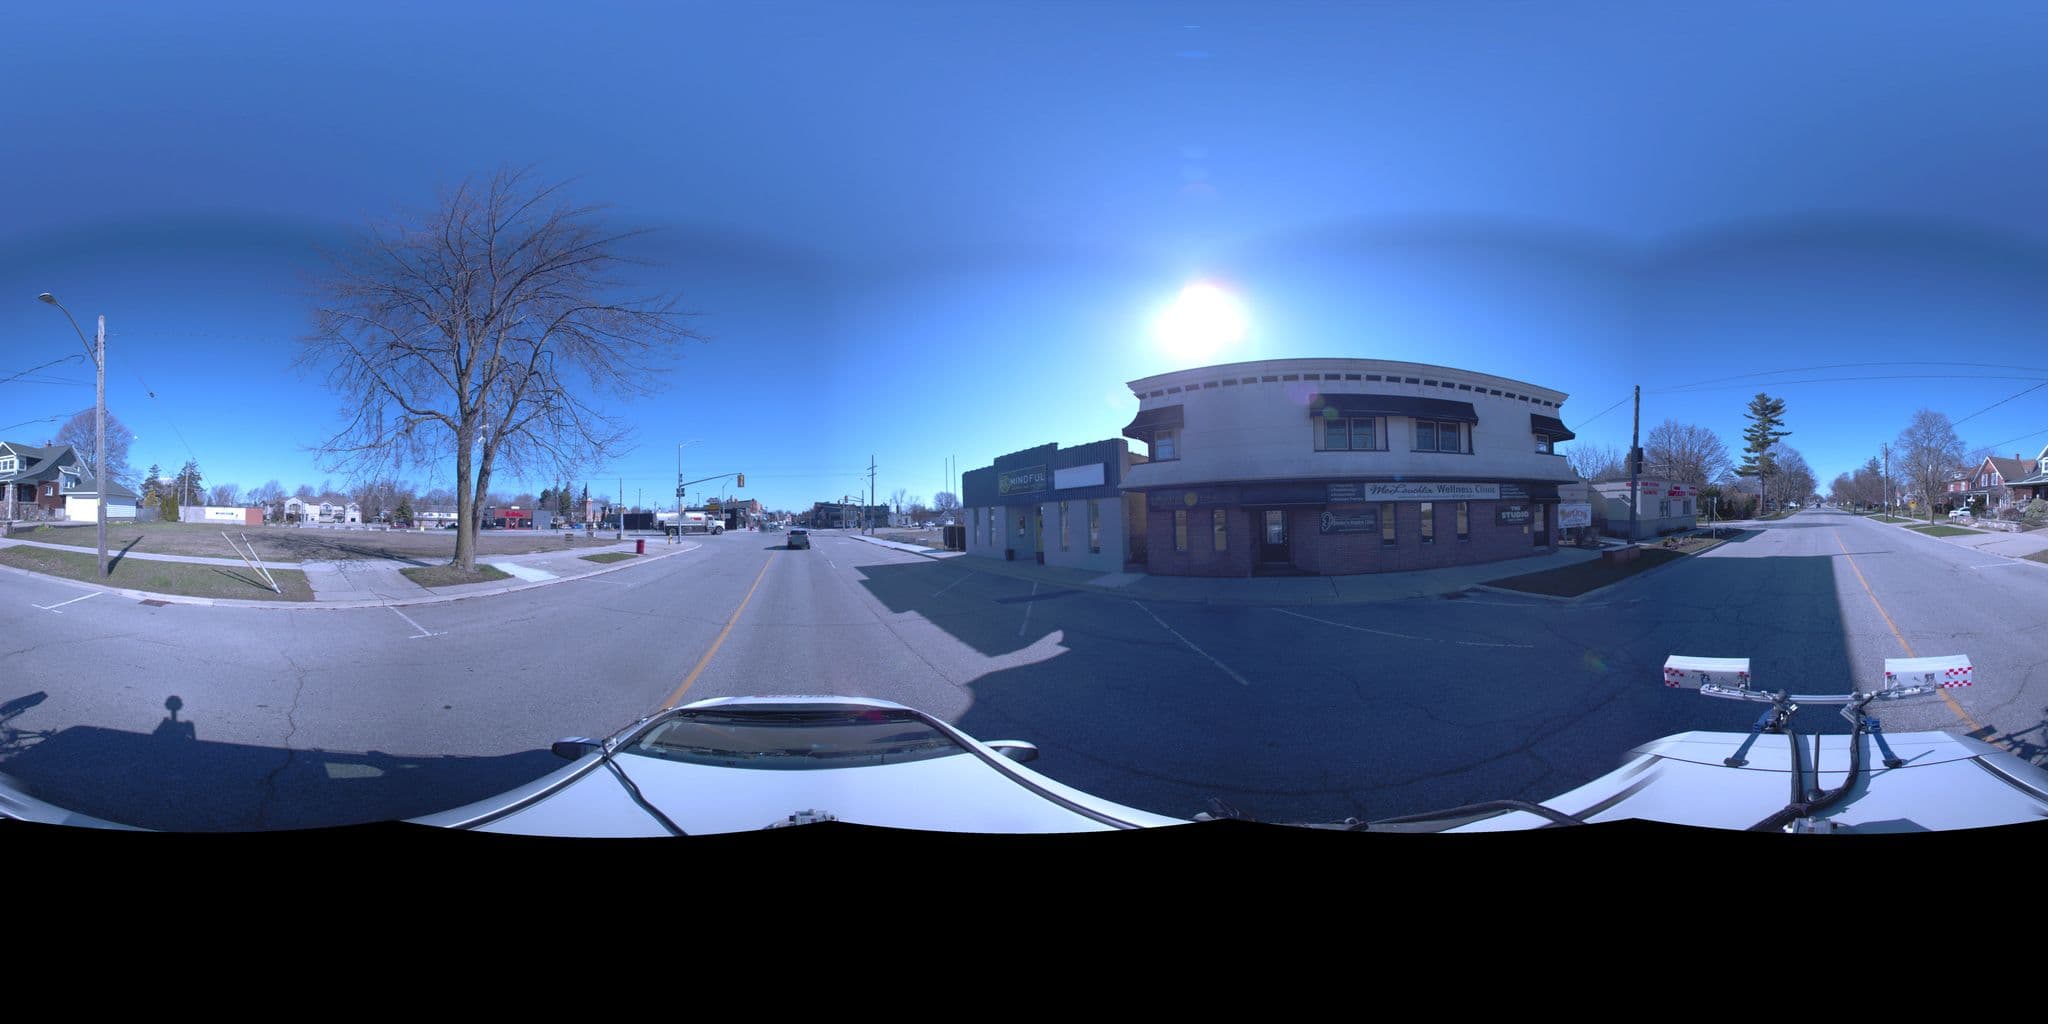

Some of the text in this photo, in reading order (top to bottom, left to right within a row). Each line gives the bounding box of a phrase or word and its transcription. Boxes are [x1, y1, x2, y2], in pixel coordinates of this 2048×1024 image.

[1009, 472, 1045, 485] MINDFUL
[1437, 484, 1473, 493] Wellness
[1501, 511, 1529, 519] STUDIO
